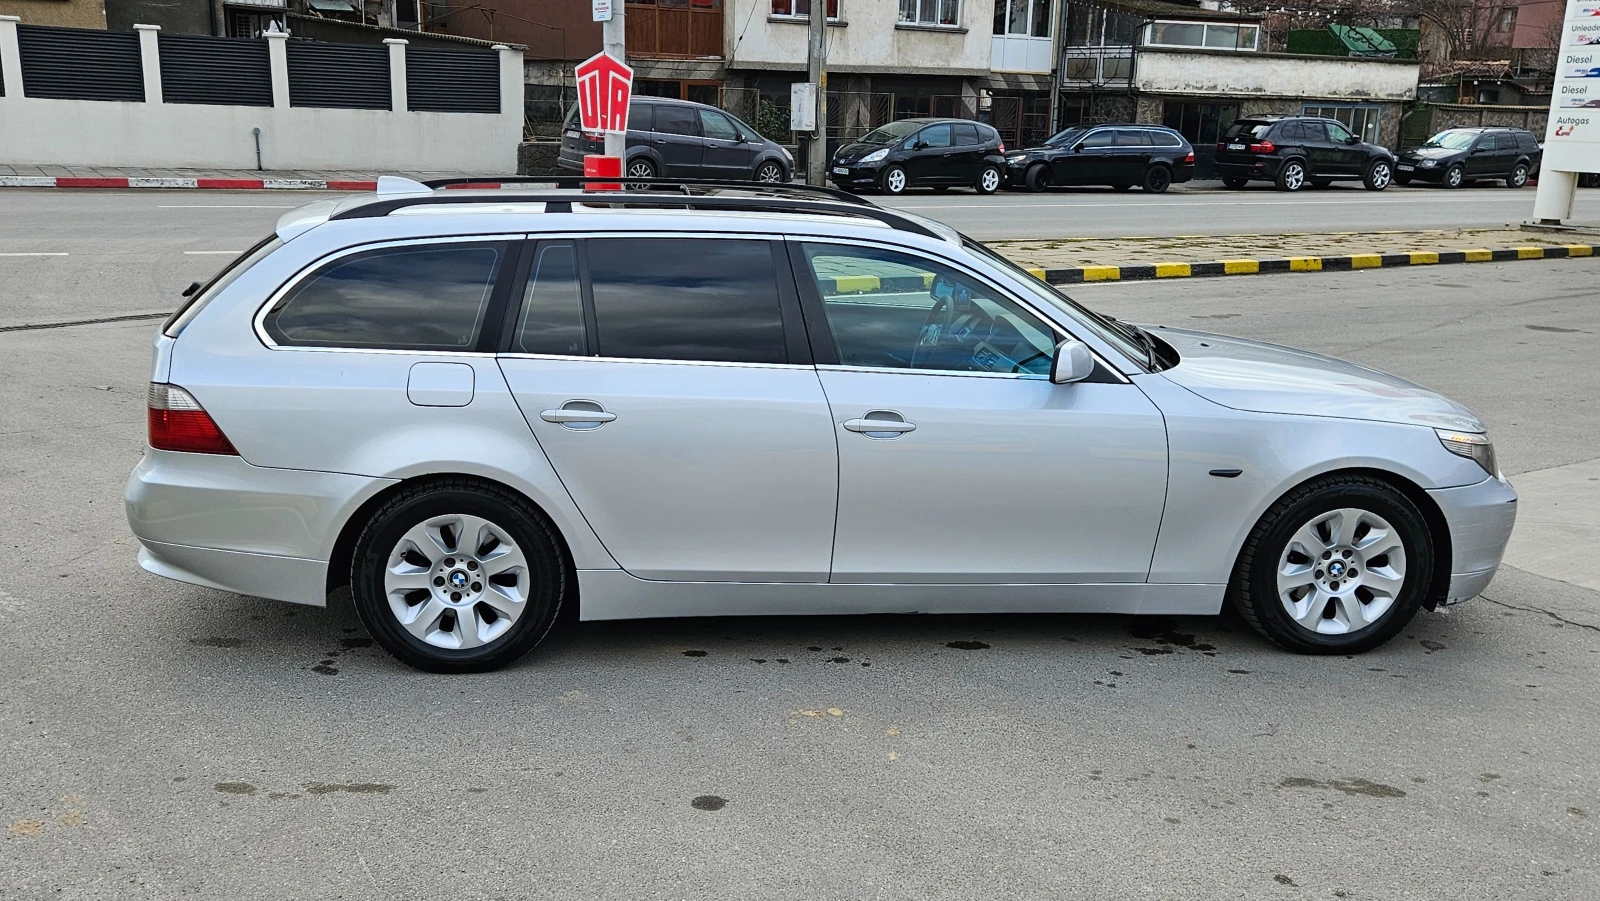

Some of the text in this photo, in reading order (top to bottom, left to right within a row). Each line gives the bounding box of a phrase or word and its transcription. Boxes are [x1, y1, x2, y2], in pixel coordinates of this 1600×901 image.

[1566, 55, 1593, 64] Diesel
[577, 54, 631, 131] UTA
[1561, 85, 1588, 94] Diesel
[1557, 116, 1590, 126] Autogas
